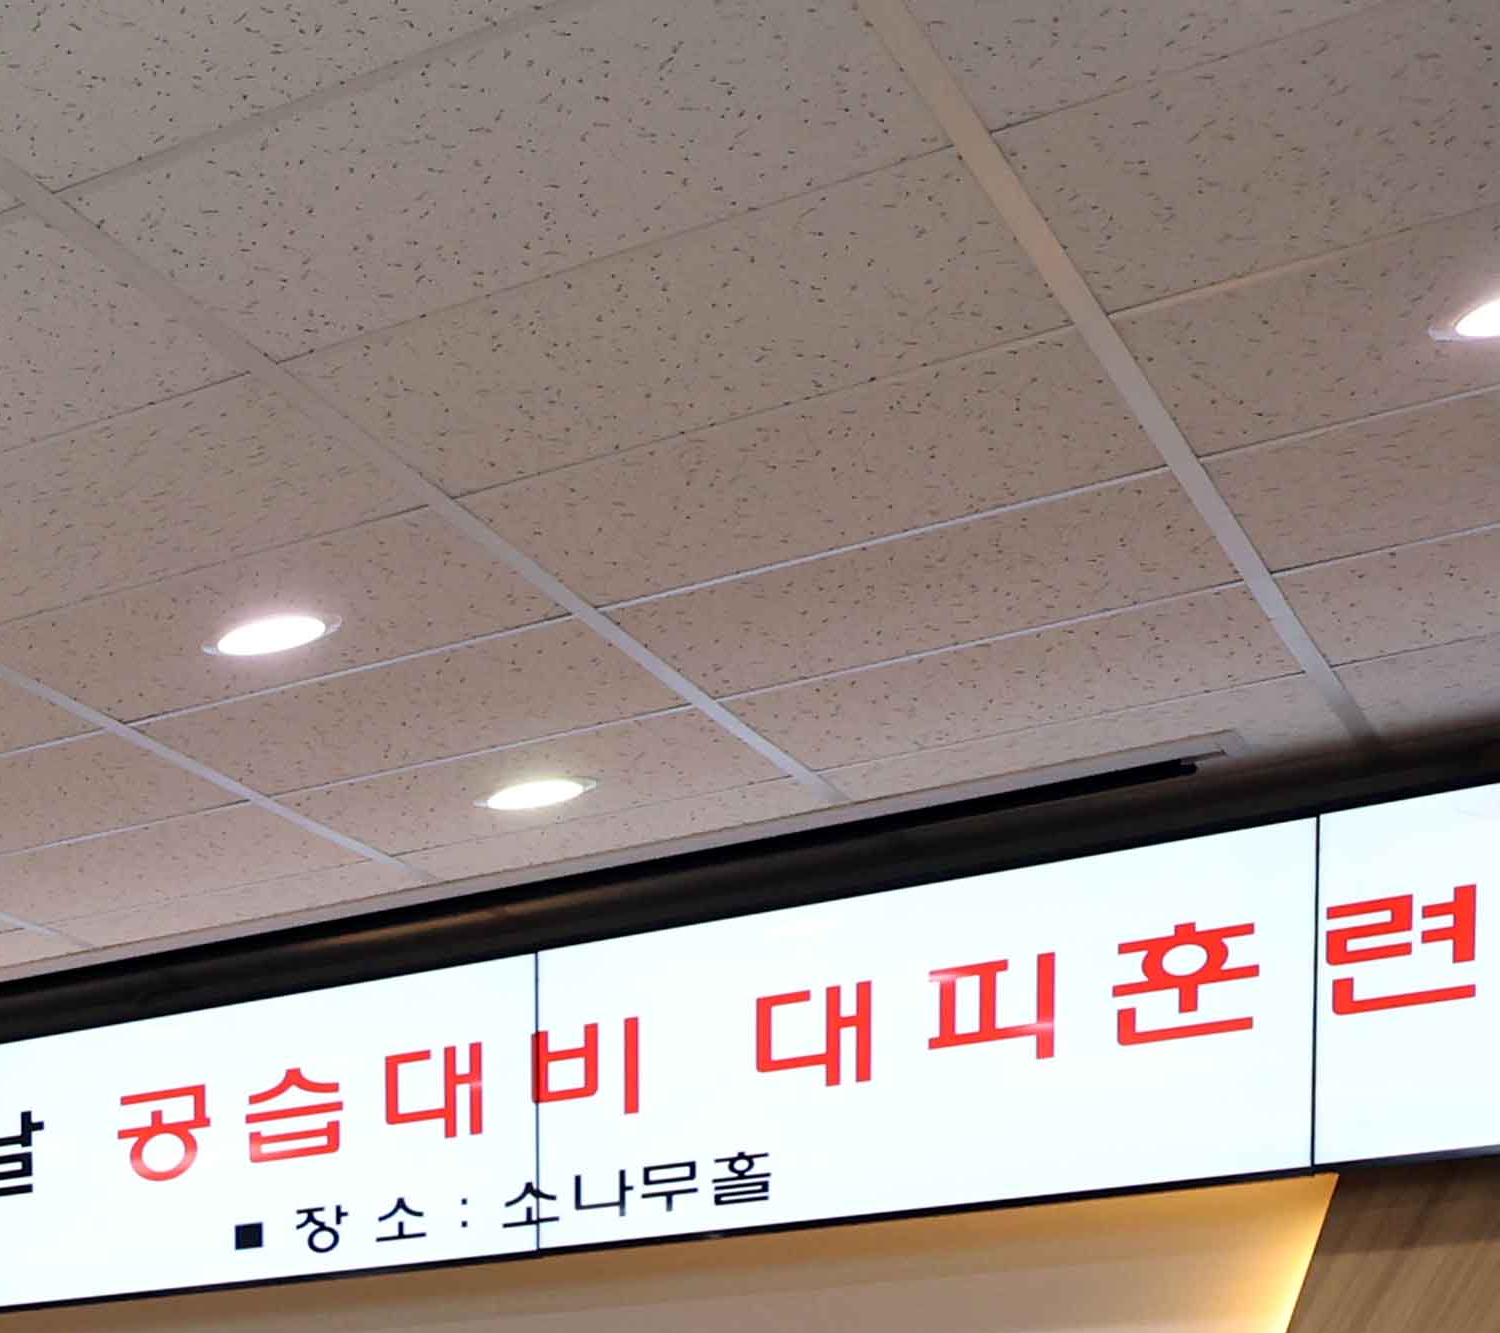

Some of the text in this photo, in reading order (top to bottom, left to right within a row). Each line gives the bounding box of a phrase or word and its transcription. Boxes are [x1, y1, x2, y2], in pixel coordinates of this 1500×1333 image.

[116, 1016, 642, 1183] 공습대비
[756, 883, 1478, 1087] 대피훈련
[501, 1151, 773, 1233] 소나무홀
